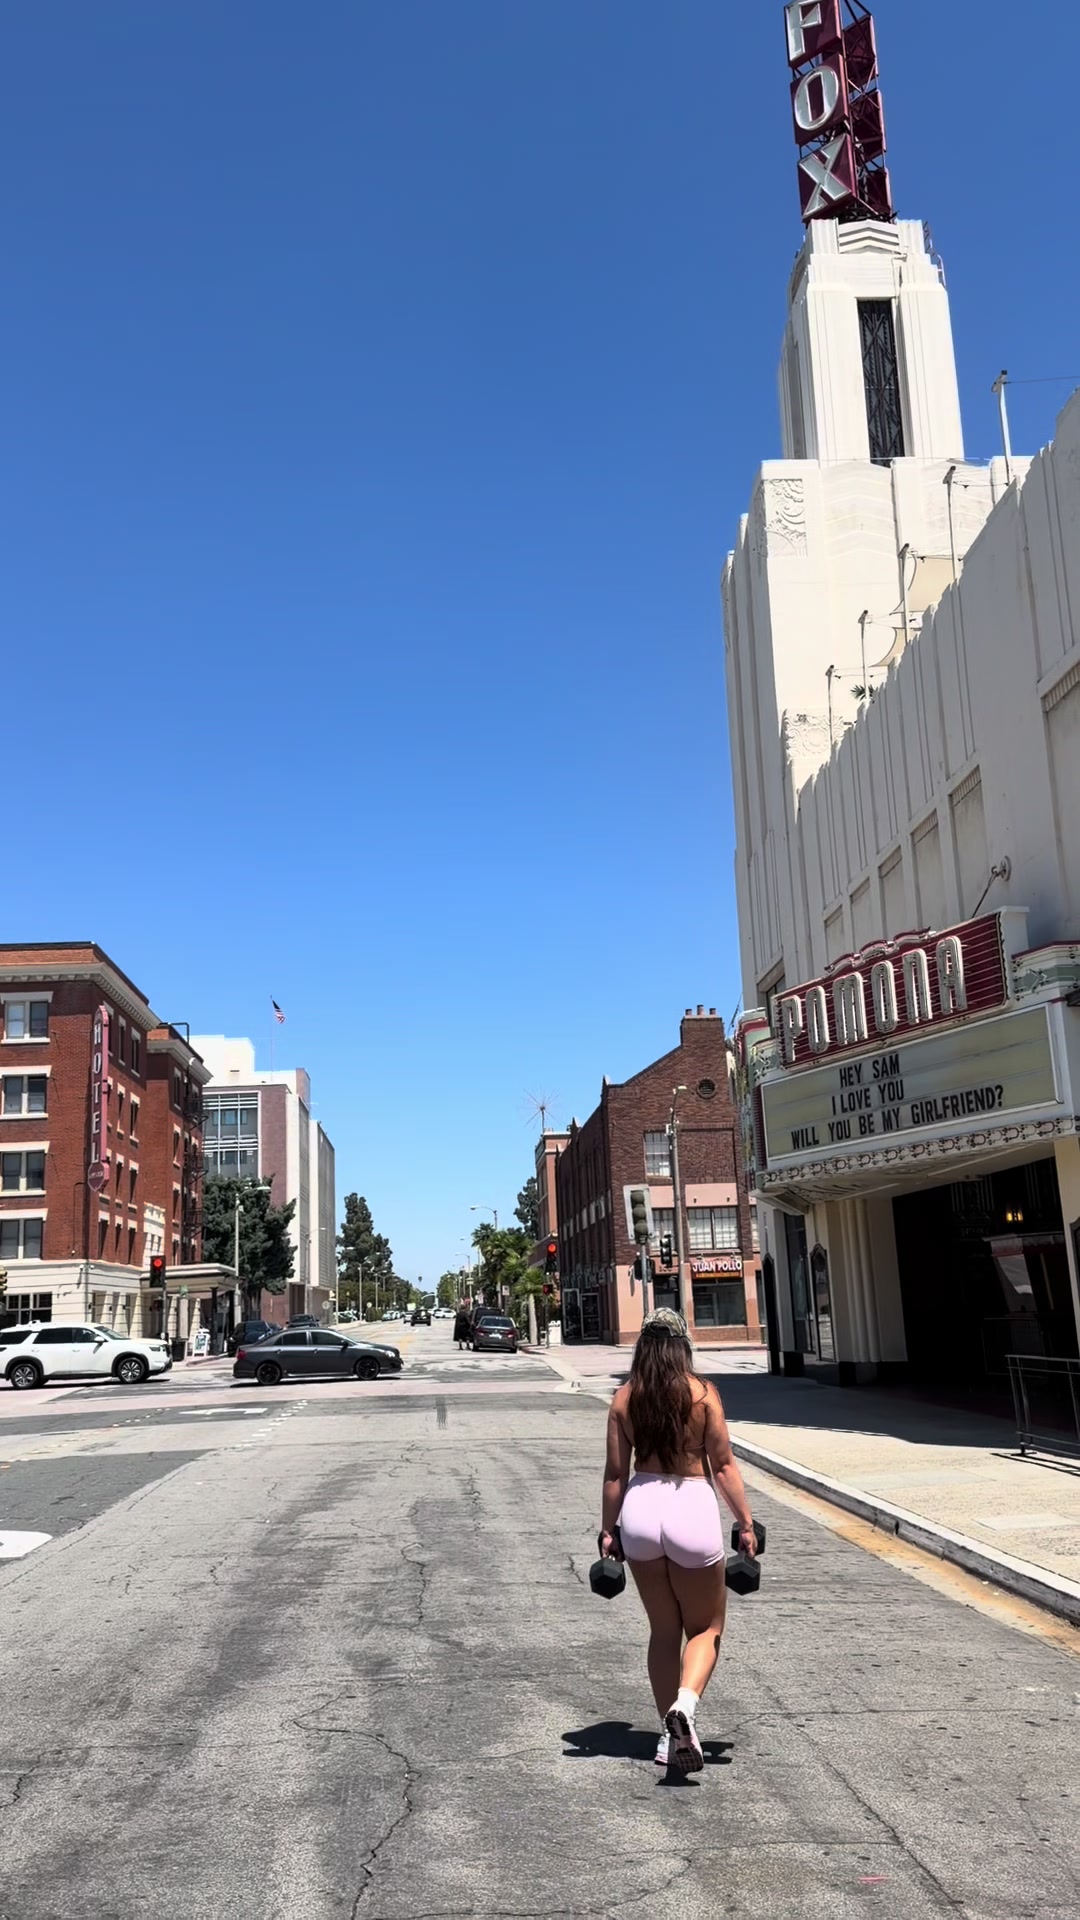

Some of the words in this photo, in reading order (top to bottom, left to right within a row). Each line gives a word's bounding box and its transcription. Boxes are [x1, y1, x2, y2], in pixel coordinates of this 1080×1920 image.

[785, 0, 850, 215] FOX
[784, 935, 968, 1062] POMONA
[91, 1023, 102, 1163] HOTEL
[832, 1096, 836, 1115] I
[841, 1087, 871, 1114] LOVE
[879, 1080, 904, 1105] YOU
[839, 1062, 862, 1088] HEY
[873, 1053, 900, 1079] SAM
[791, 1127, 819, 1150] WILL
[828, 1122, 850, 1142] YOU
[859, 1113, 874, 1135] BE
[882, 1107, 900, 1129] MY
[911, 1085, 1004, 1125] GIRLFRIEND?
[692, 1261, 715, 1272] JUAN
[716, 1260, 742, 1271] POLLO
